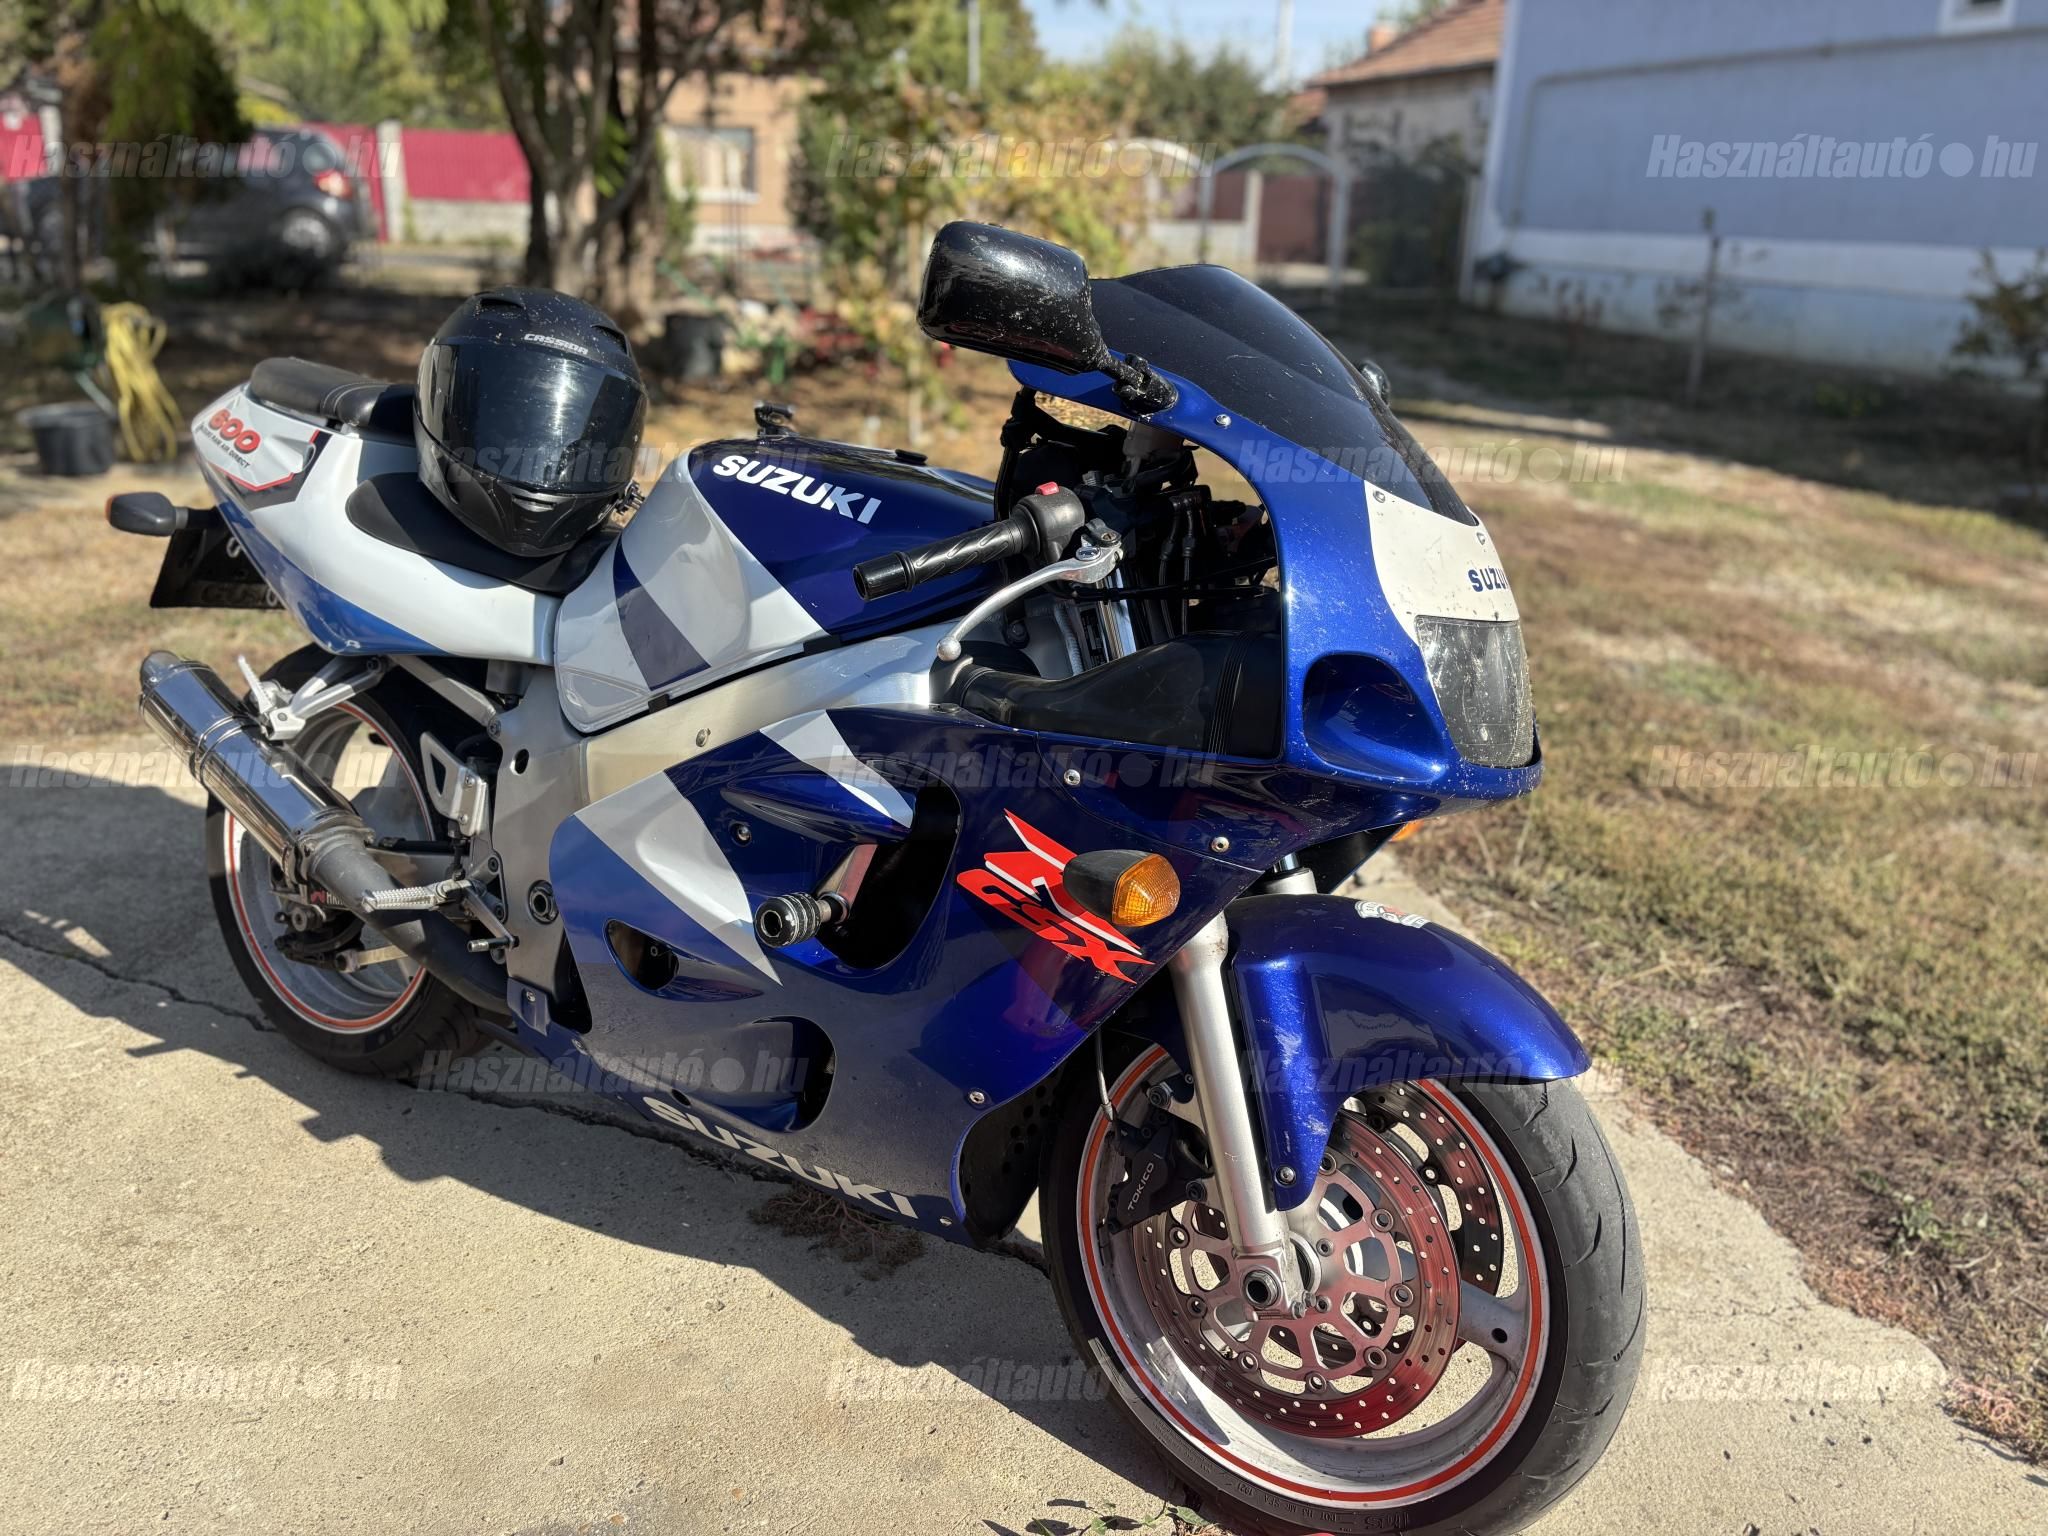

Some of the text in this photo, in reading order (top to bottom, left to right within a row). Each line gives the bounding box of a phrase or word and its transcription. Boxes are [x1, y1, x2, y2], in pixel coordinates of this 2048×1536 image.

[208, 409, 261, 454] 600
[713, 455, 882, 525] SUZUKI
[643, 1096, 918, 1219] SUZUKI
[1127, 1162, 1155, 1211] TOKICO
